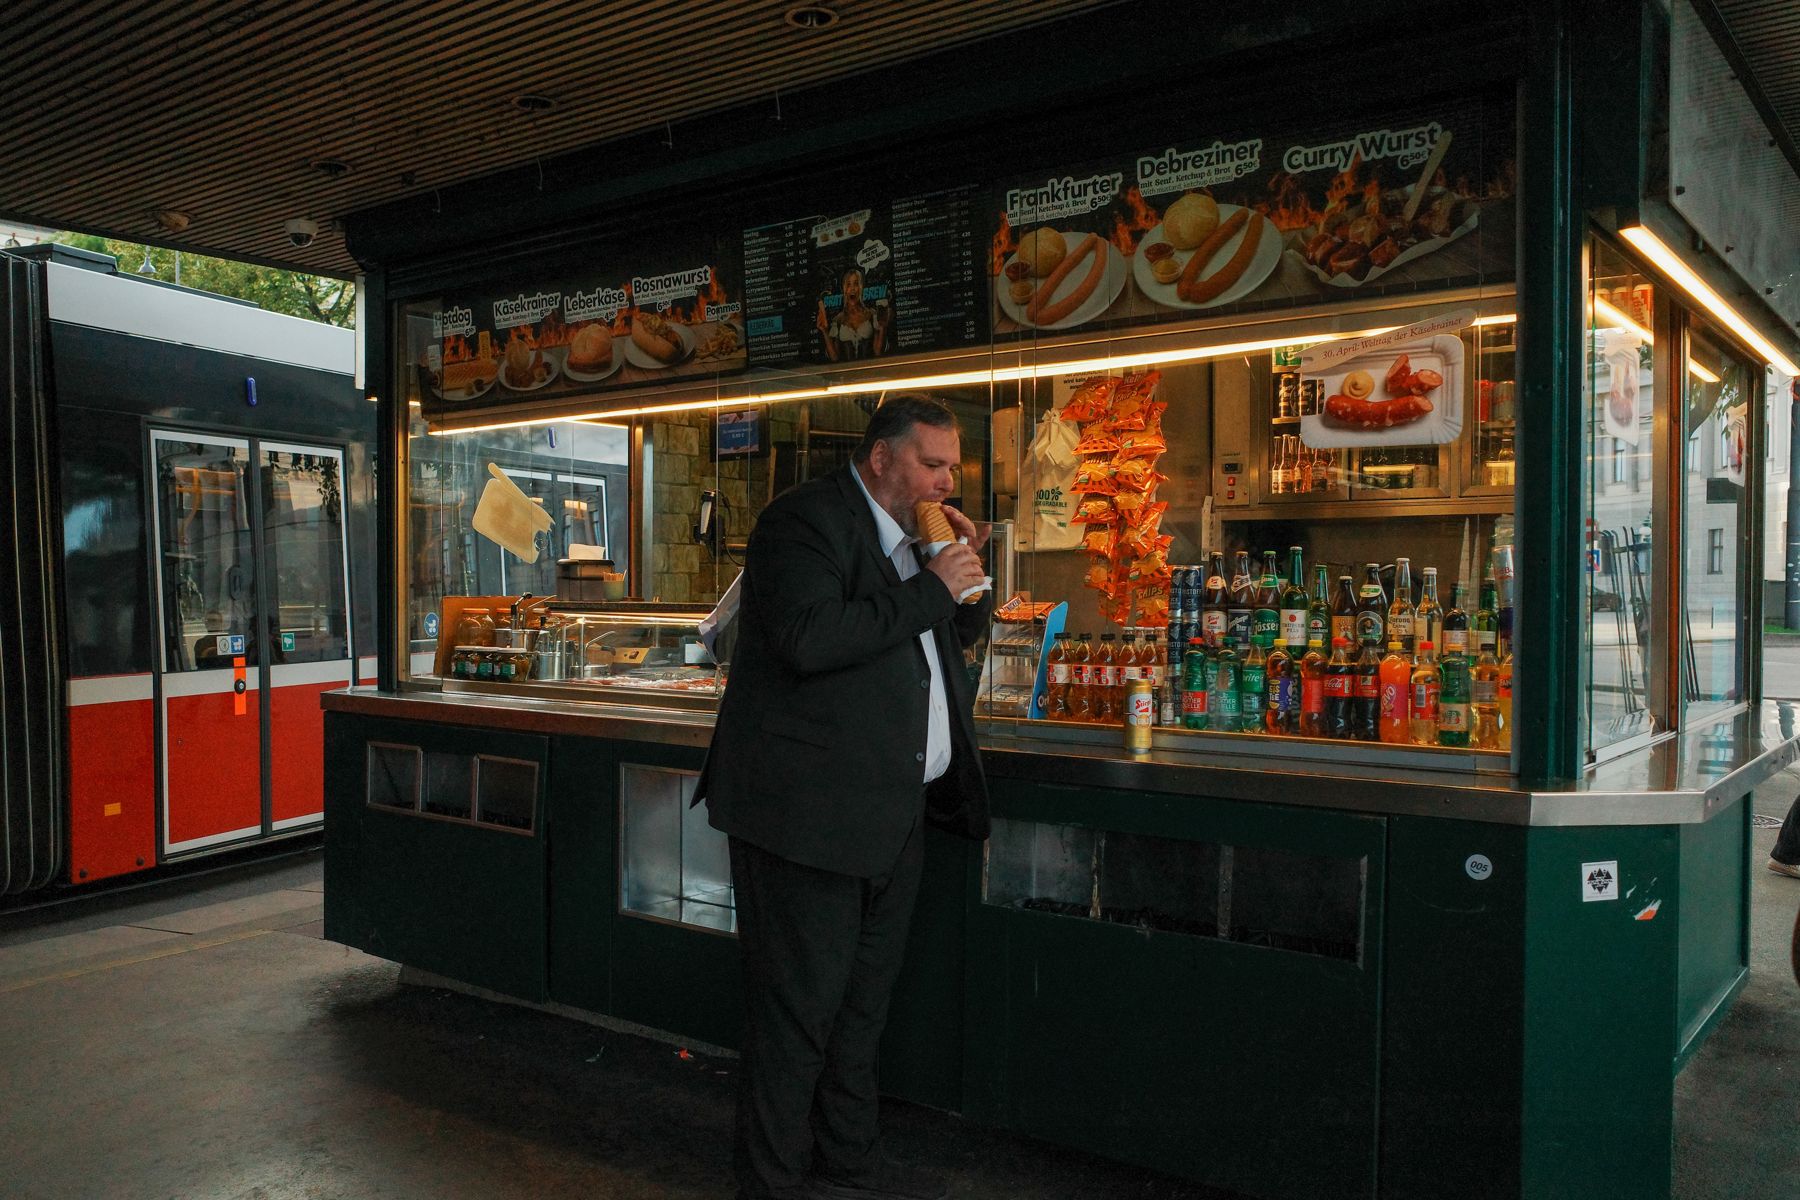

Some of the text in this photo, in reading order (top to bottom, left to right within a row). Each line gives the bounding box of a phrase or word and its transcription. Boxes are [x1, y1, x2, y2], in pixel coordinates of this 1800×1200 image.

[1286, 125, 1439, 170] Curry Wurst
[1140, 142, 1259, 180] Debreziner
[1176, 171, 1206, 184] Ketchup
[1214, 167, 1231, 176] Brot
[1009, 176, 1121, 211] Frankfurter
[1008, 211, 1019, 220] mit
[1038, 202, 1065, 214] Ketchup
[1072, 198, 1088, 207] Brot
[634, 268, 710, 293] Bosnawurst
[495, 294, 560, 317] Käsekrainer
[565, 290, 625, 313] Leberkäse
[706, 303, 740, 316] Pommes
[433, 308, 471, 328] Hotdog
[1336, 343, 1360, 357] April:
[1361, 336, 1393, 350] Welttag
[1394, 331, 1409, 341] der
[1410, 318, 1463, 338] Käsekrainer
[1470, 861, 1488, 872] 005
